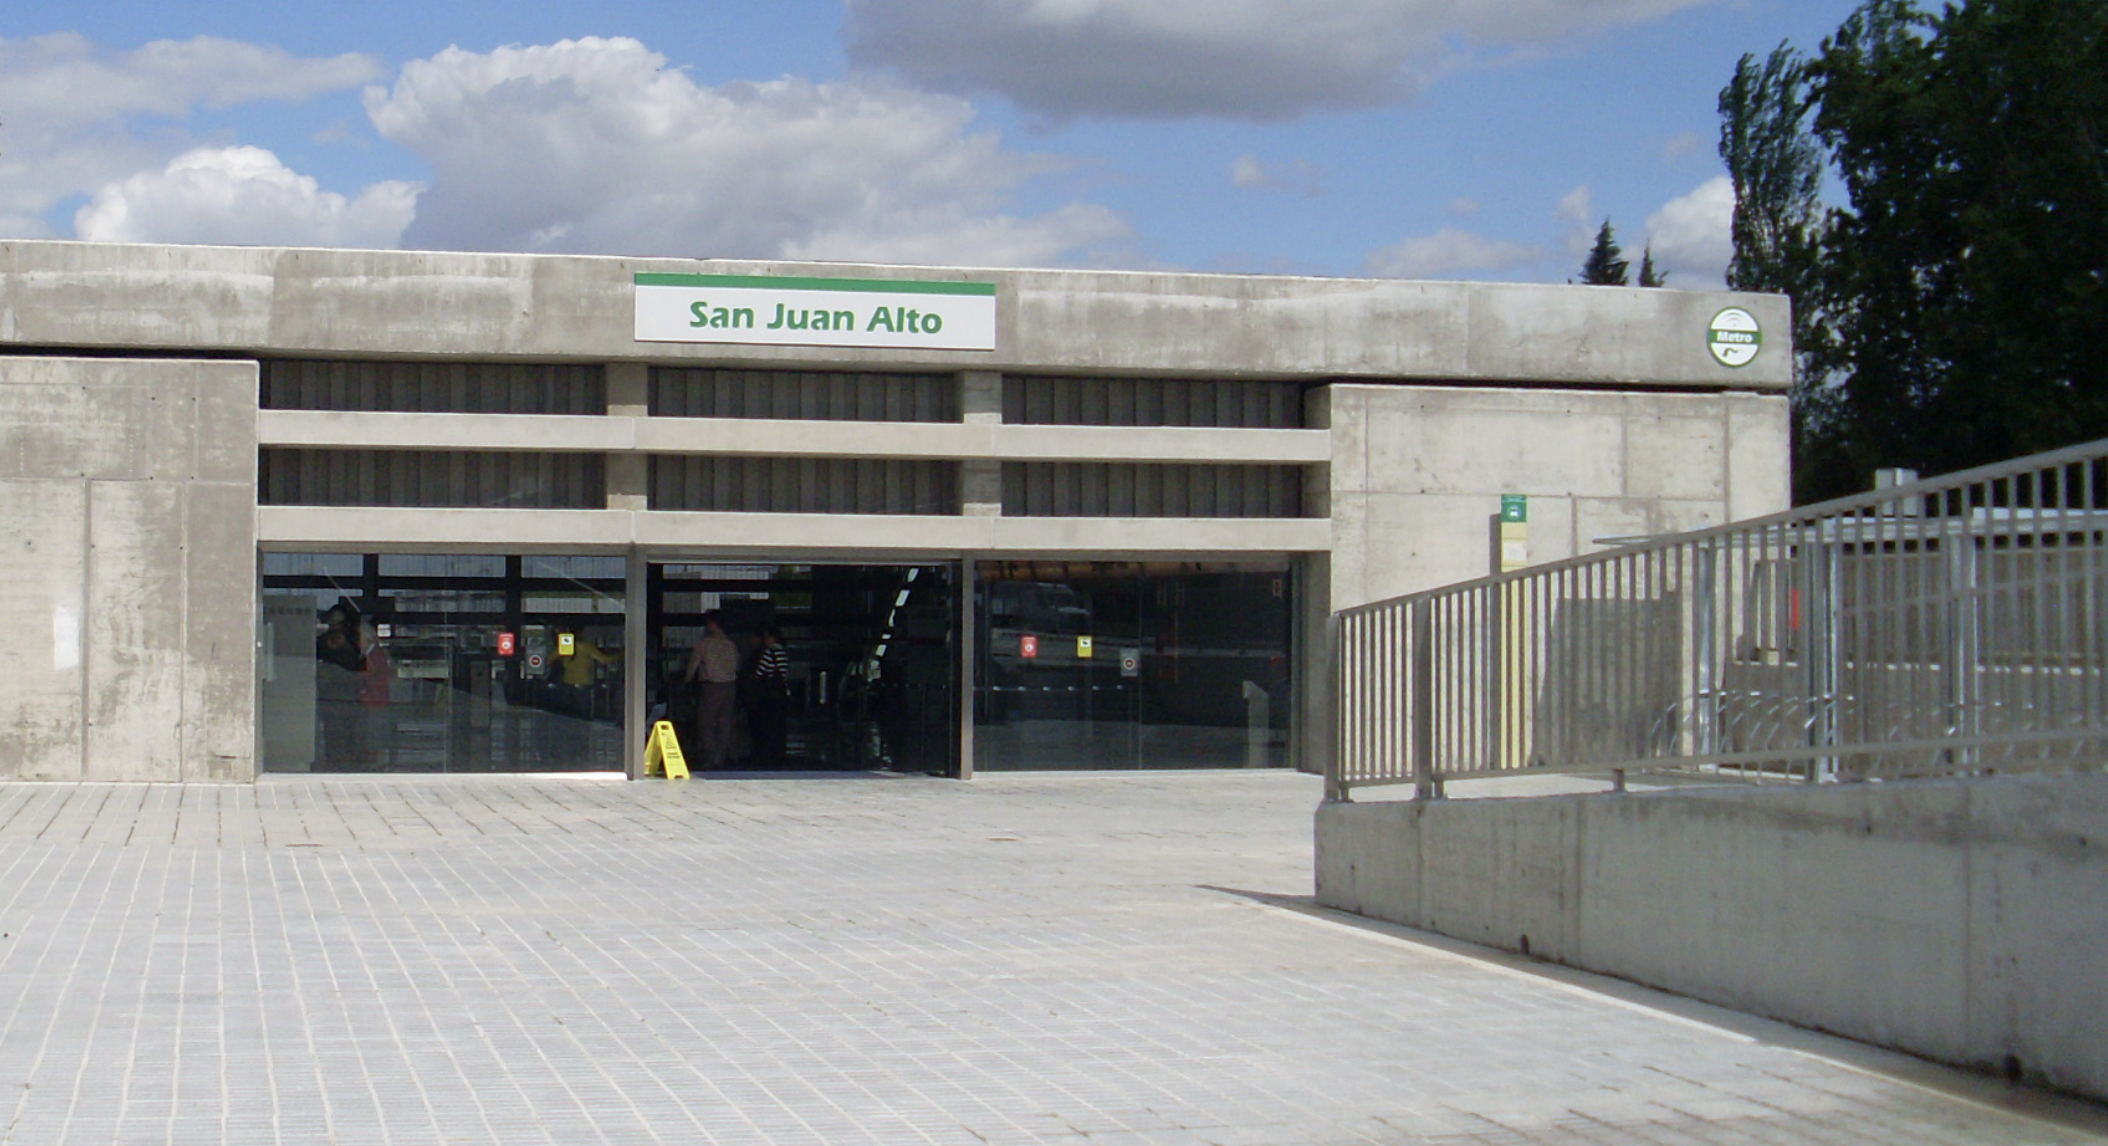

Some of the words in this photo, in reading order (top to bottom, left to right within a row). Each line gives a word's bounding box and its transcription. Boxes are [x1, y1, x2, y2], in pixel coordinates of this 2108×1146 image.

[690, 301, 754, 328] San
[767, 303, 855, 331] Juan
[866, 306, 943, 334] Alto
[1717, 331, 1753, 343] Metro
